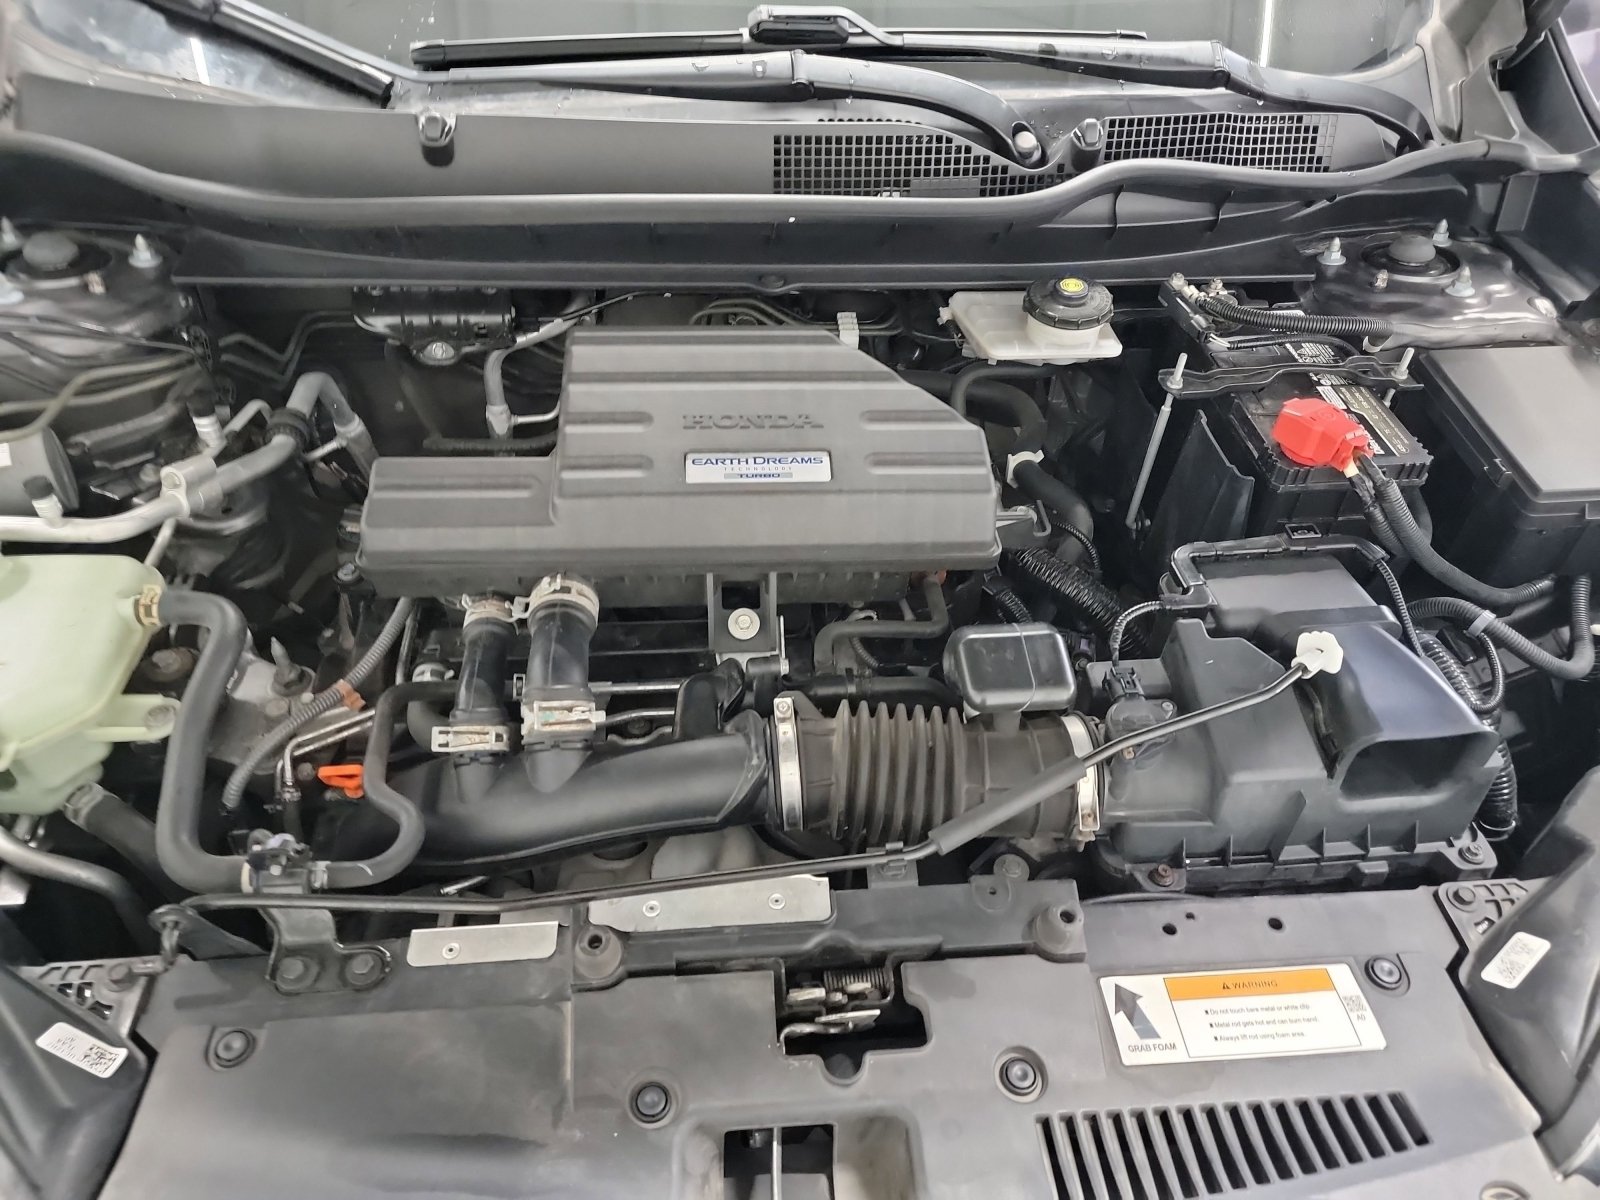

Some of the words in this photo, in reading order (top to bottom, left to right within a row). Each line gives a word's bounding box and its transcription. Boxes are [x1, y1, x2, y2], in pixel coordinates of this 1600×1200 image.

[682, 414, 824, 430] HONDA
[691, 456, 749, 466] EARTH
[753, 456, 824, 465] DREAMS
[1232, 980, 1278, 989] WARNING
[1242, 1020, 1254, 1028] gets
[1219, 1035, 1240, 1043] Always
[1259, 1033, 1275, 1041] using
[1128, 1044, 1152, 1052] GRAB
[1152, 1042, 1177, 1051] FOAM
